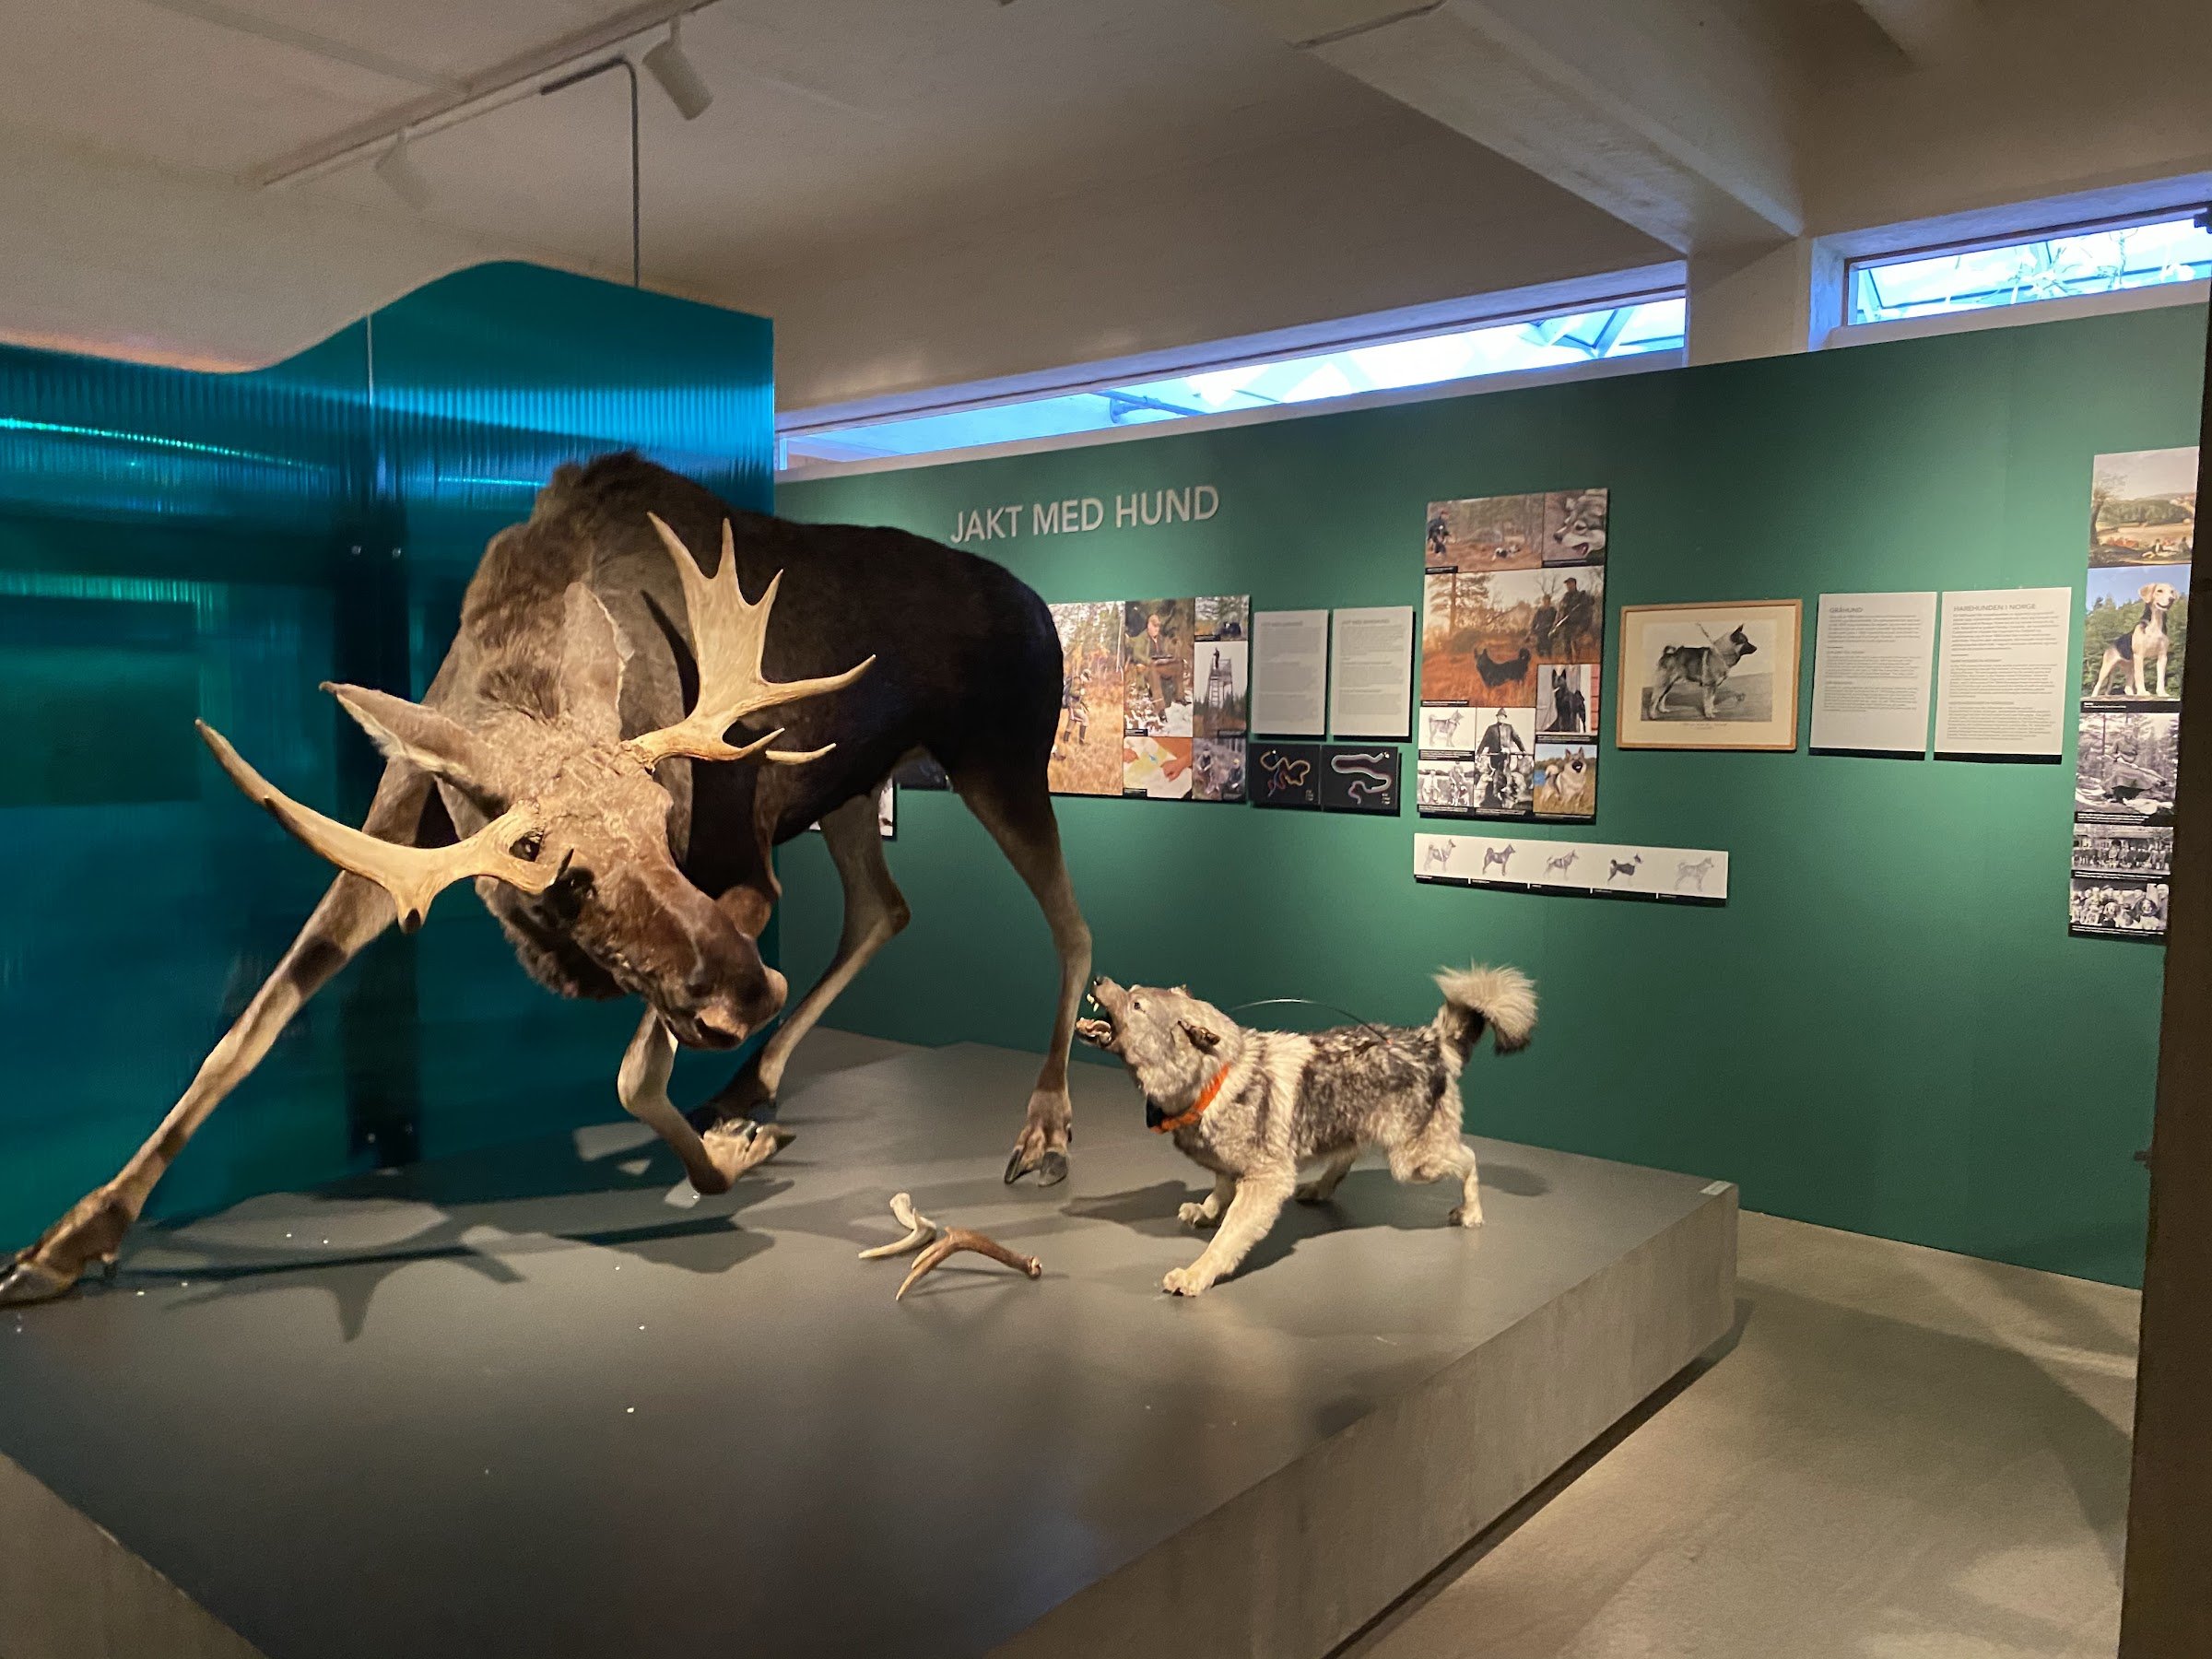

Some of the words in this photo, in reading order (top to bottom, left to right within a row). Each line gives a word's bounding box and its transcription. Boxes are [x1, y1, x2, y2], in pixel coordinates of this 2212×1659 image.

[950, 505, 1023, 544] JAKT
[1032, 498, 1104, 536] MED
[1115, 486, 1219, 528] HUND
